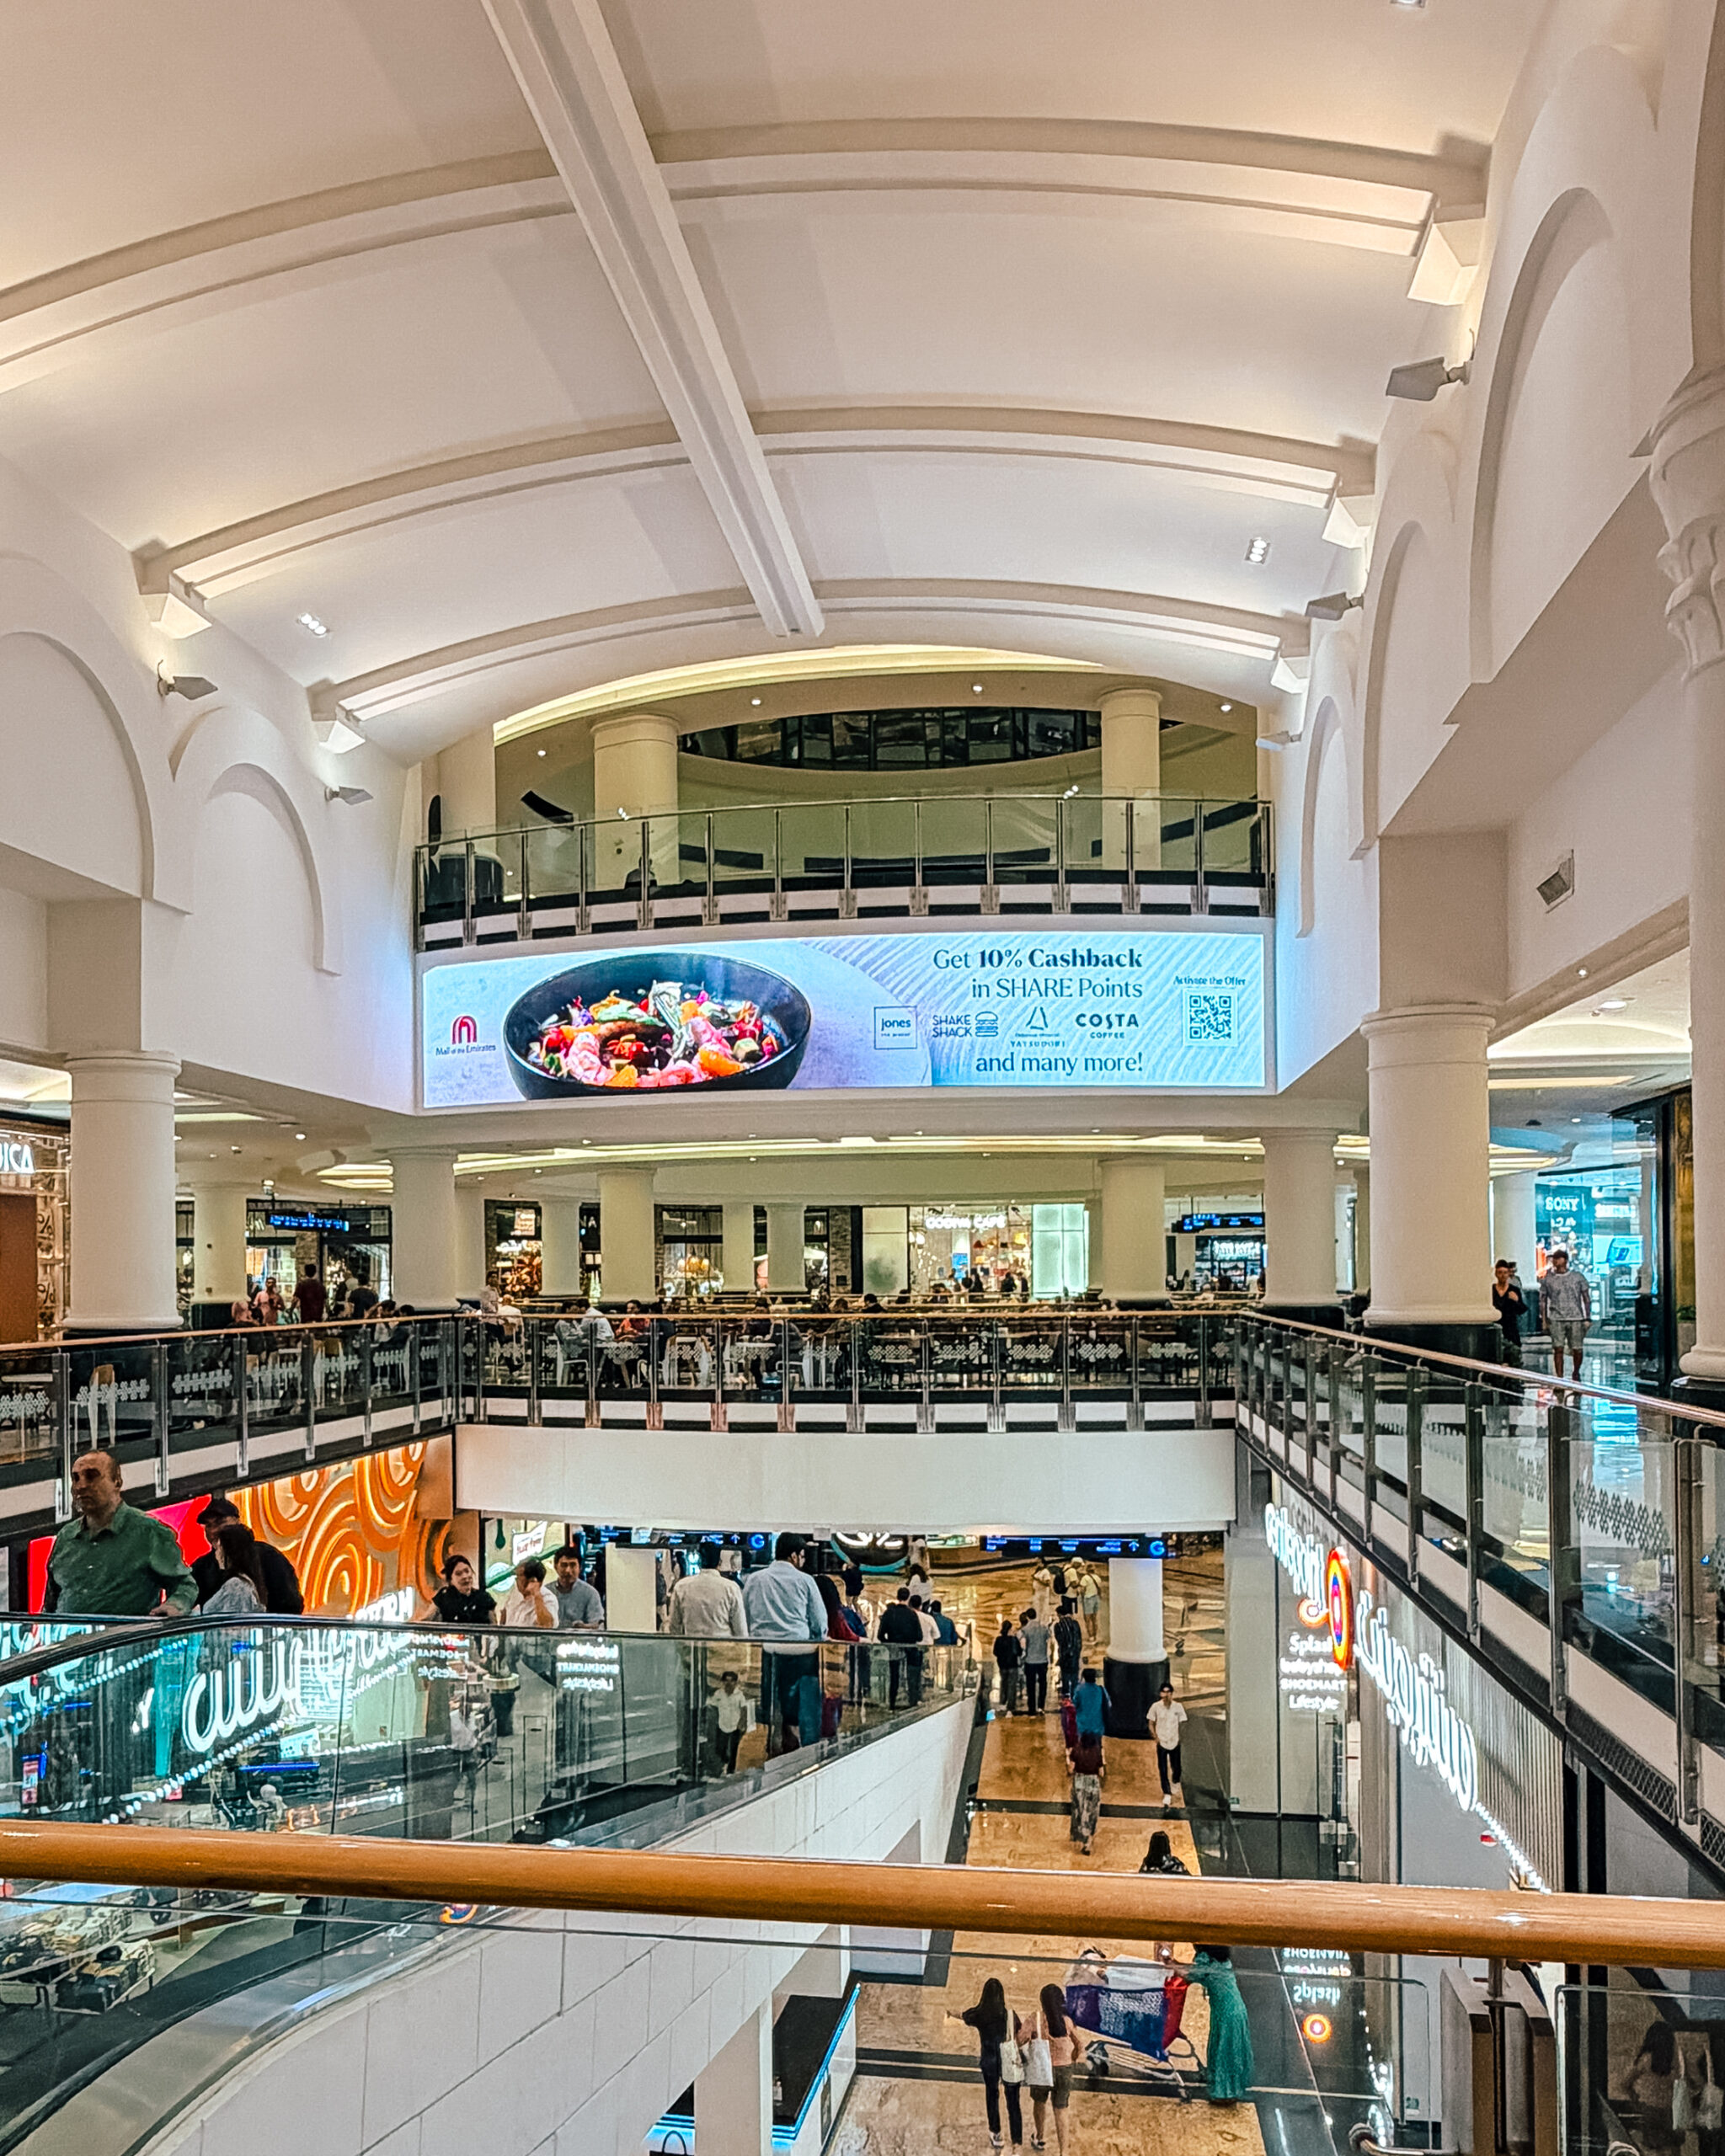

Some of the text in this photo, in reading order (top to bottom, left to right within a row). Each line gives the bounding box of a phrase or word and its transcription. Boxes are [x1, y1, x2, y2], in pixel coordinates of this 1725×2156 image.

[933, 947, 1143, 969] Get 10% Cashback
[972, 977, 1143, 998] in SHARE Points
[1210, 976, 1223, 985] the
[932, 1014, 971, 1026] SHAKE
[1075, 1012, 1139, 1029] COSTA
[932, 1026, 973, 1038] SHACK
[435, 1047, 450, 1056] Mall
[467, 1043, 496, 1054] Emirates
[975, 1052, 1144, 1076] and many more!
[1545, 1197, 1580, 1212] SONY
[750, 1534, 765, 1549] G
[1150, 1540, 1165, 1556] G
